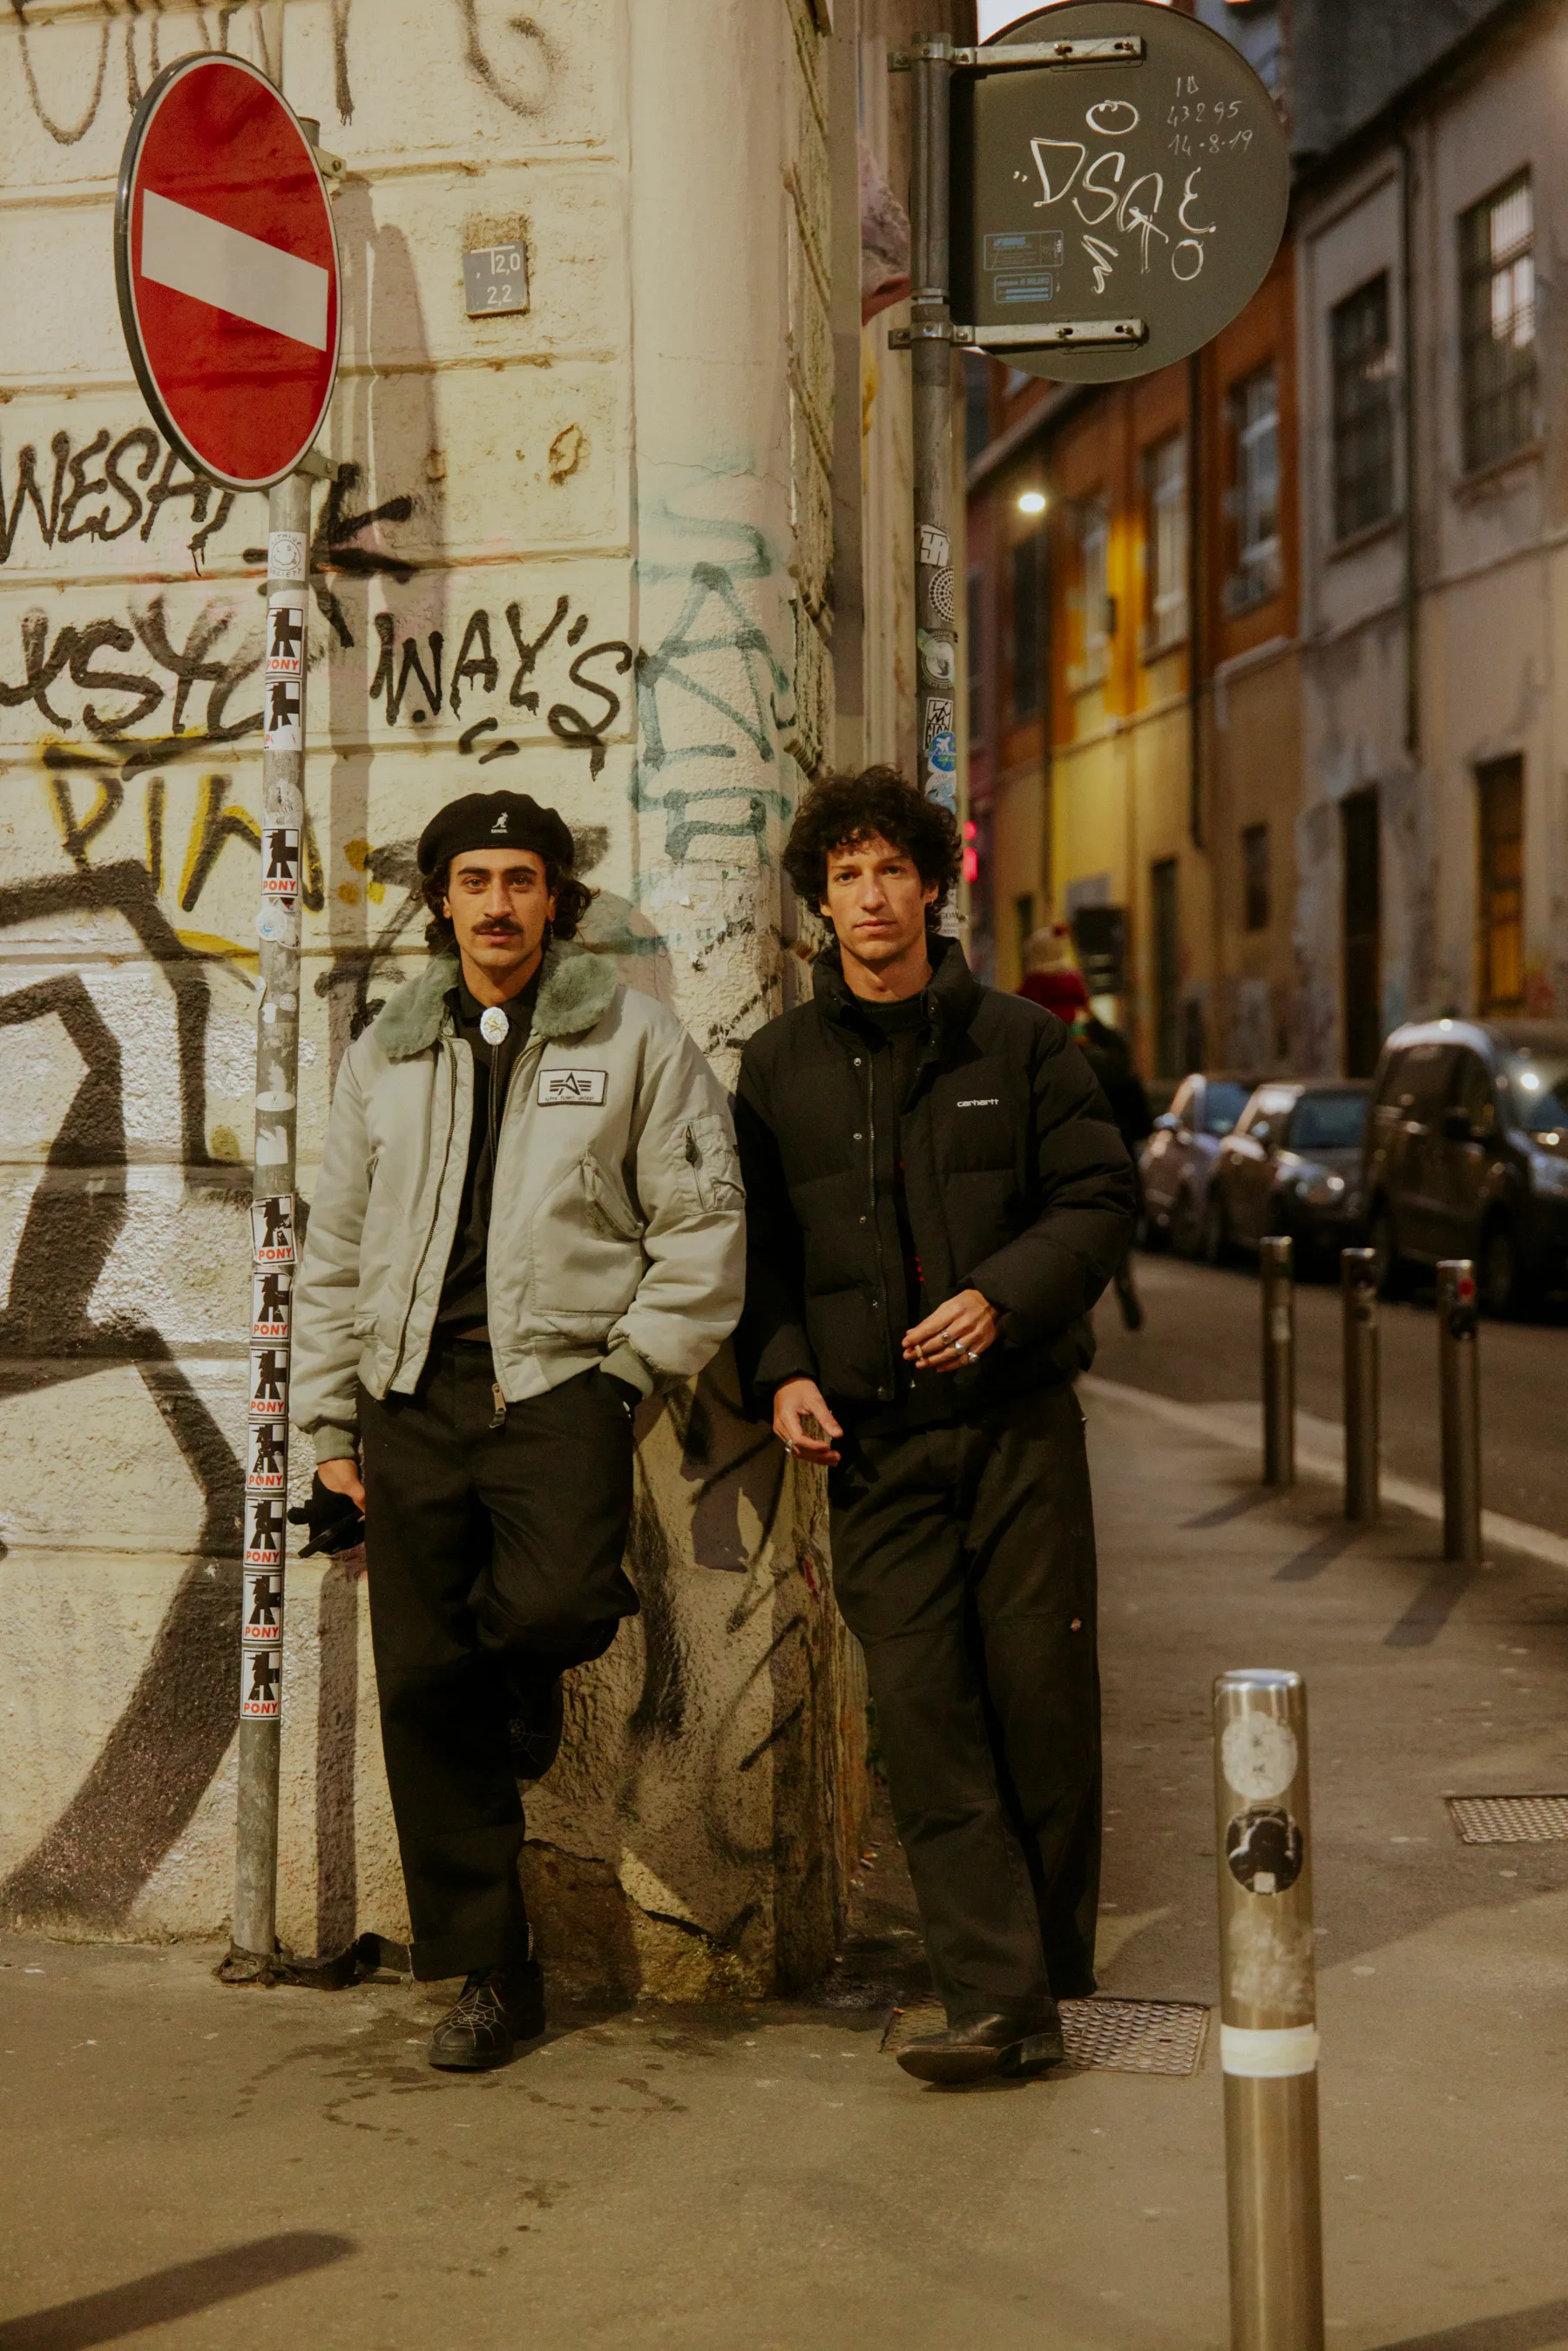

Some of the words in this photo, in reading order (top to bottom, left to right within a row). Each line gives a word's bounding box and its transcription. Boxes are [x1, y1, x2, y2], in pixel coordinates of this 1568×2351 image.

[266, 658, 300, 671] PONY
[262, 880, 298, 891] PONY
[956, 1098, 999, 1107] carhartt
[258, 1247, 292, 1261] PONY
[253, 1323, 287, 1335] PONY
[250, 1401, 284, 1414] PONY
[248, 1474, 283, 1487] PONY
[246, 1550, 280, 1564] PONY
[244, 1625, 279, 1638] PONY
[243, 1702, 278, 1715] PONY
